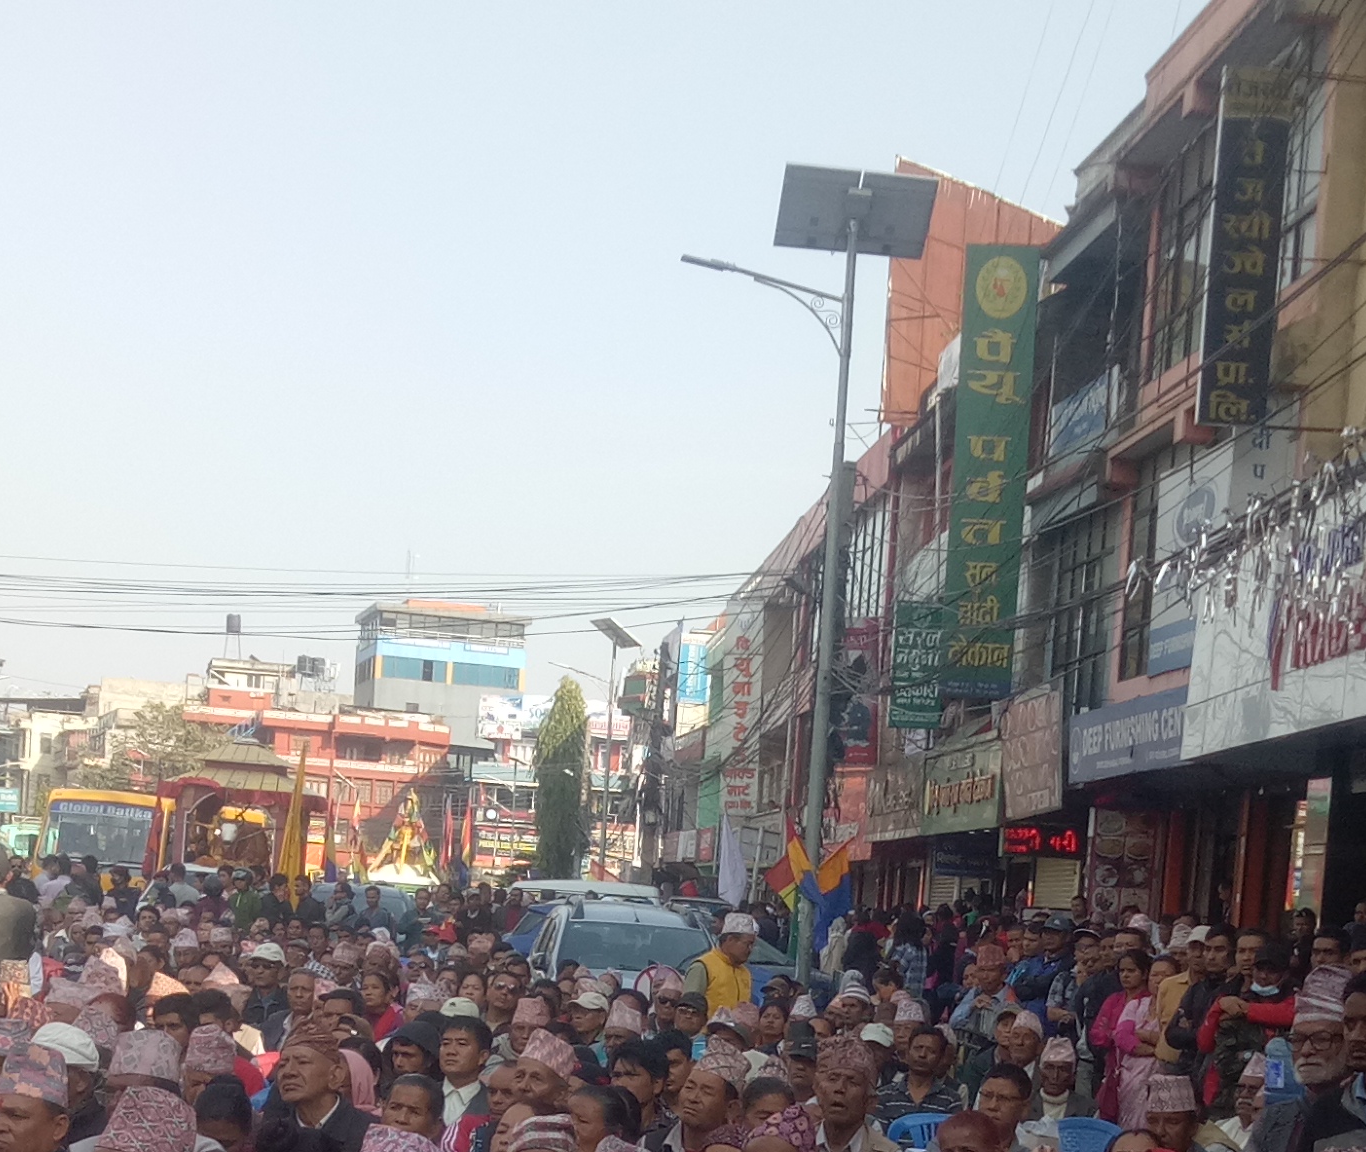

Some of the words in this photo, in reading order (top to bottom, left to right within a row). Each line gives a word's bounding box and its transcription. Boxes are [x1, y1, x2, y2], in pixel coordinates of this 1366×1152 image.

[1082, 725, 1103, 757] DEEP
[1103, 708, 1160, 751] FURNISHING
[1160, 705, 1184, 742] CEN
[58, 802, 104, 815] Global
[107, 805, 152, 819] Batika
